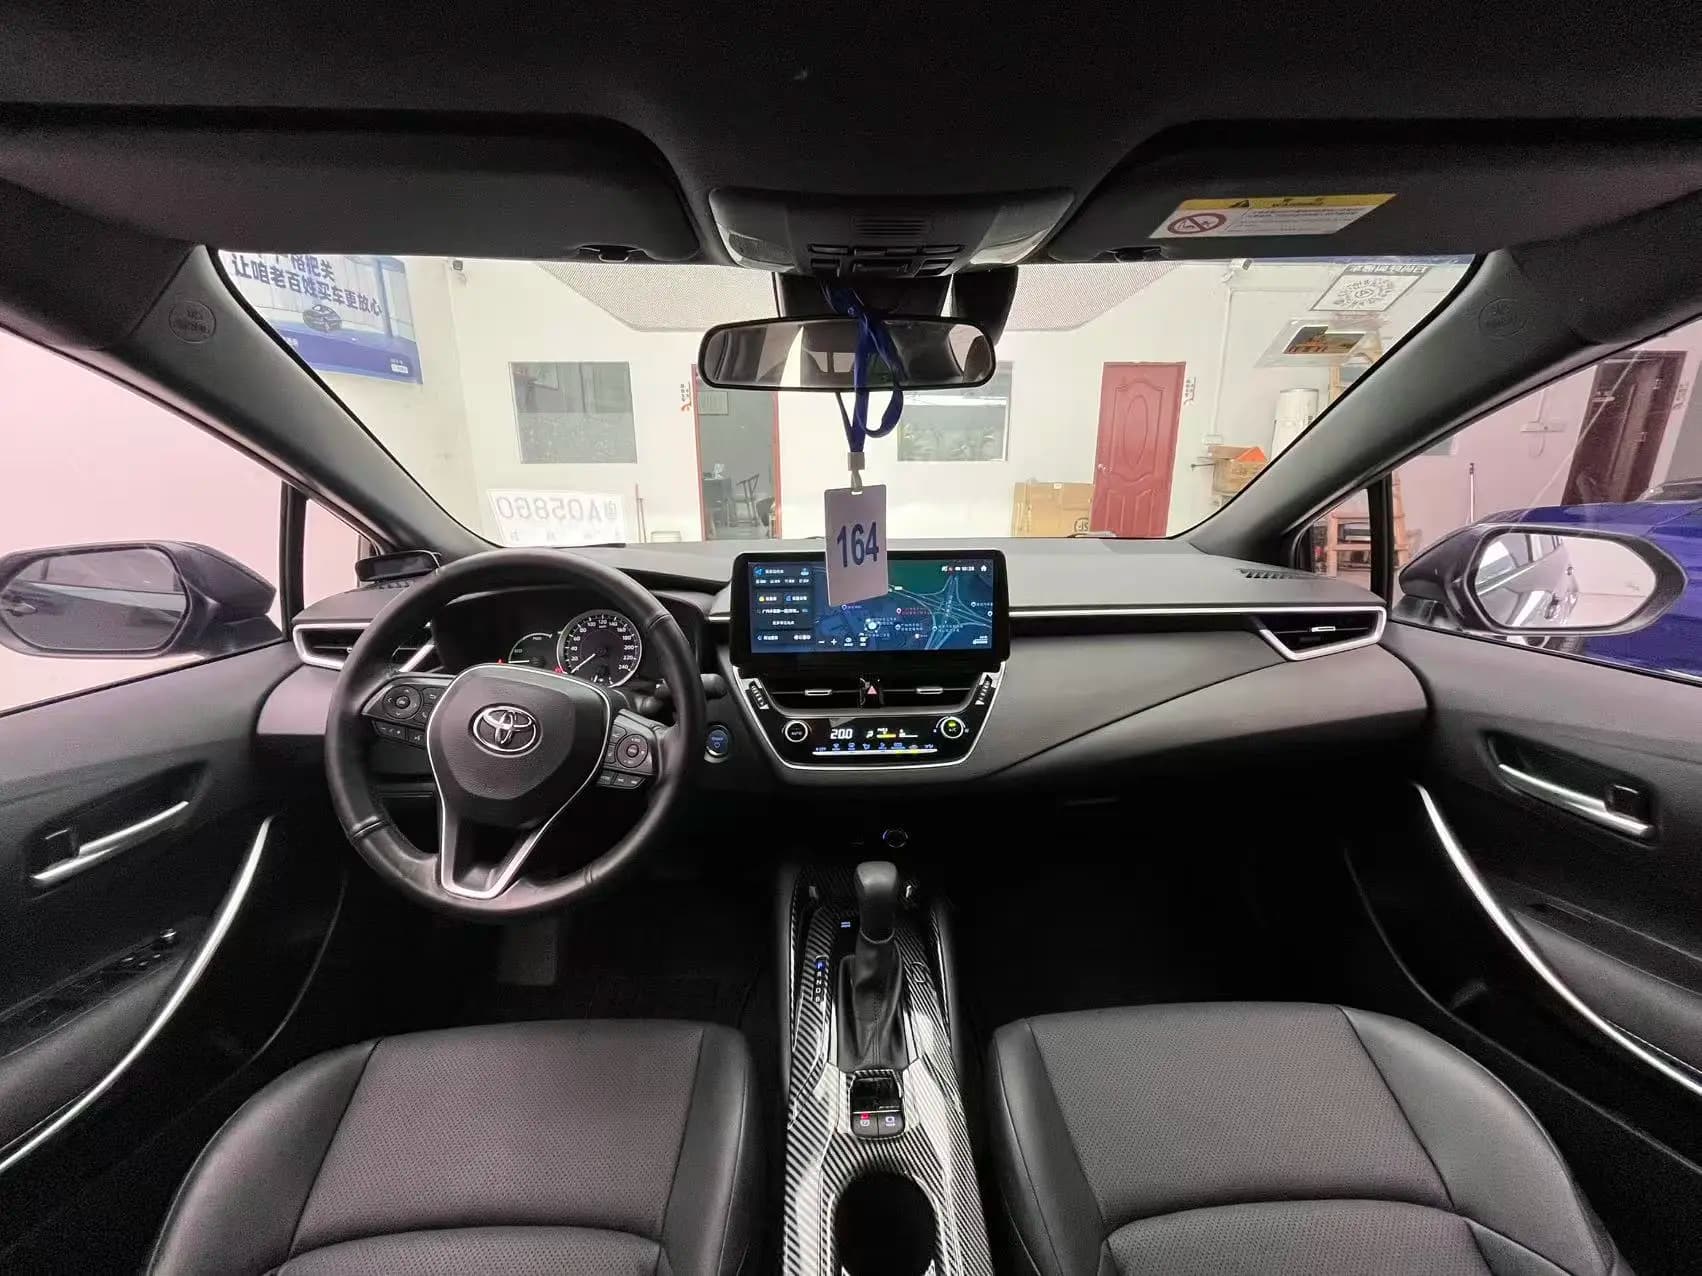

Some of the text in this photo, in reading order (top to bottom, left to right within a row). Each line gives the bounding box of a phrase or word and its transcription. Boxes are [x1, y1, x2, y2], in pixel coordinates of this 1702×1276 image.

[231, 254, 383, 316] 让咱老百姓买车更放心
[837, 521, 879, 568] 164
